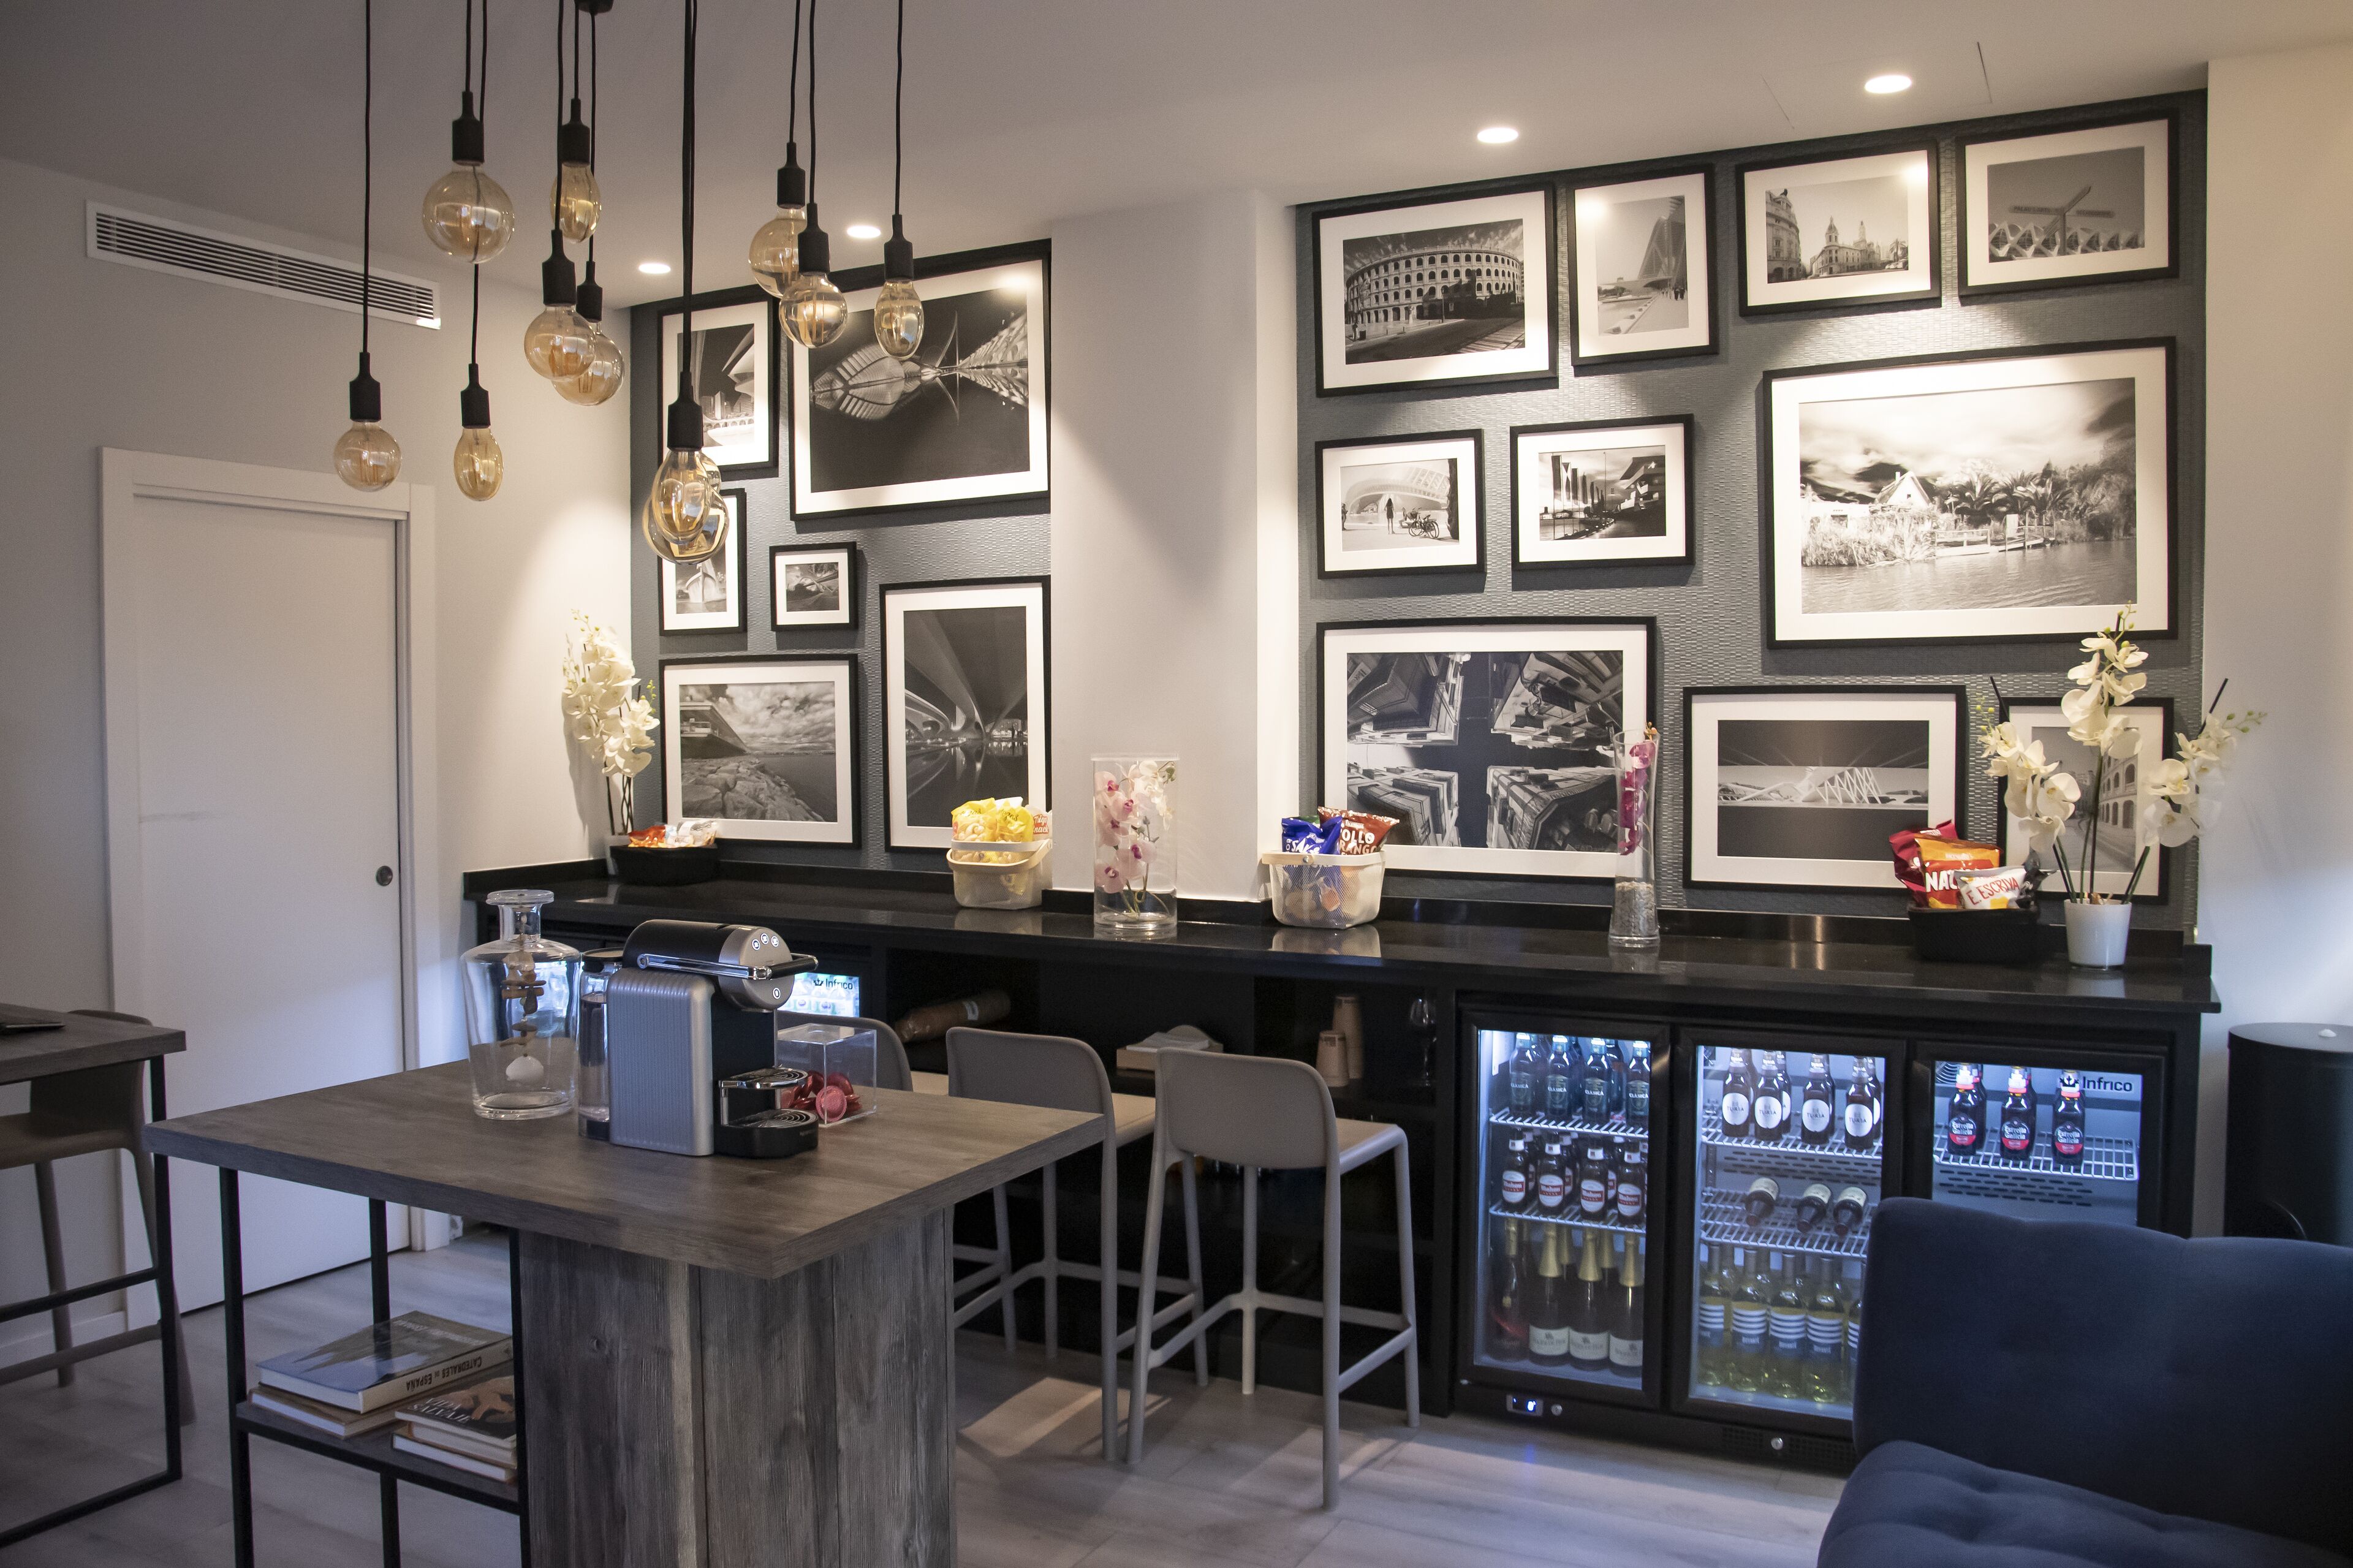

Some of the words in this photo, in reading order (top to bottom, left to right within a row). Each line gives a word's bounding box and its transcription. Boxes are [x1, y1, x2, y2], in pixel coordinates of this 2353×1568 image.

[1341, 828, 1374, 844] OLLO
[1925, 869, 1970, 893] NAC
[825, 978, 853, 990] Infrico
[2083, 1076, 2133, 1092] Infrico
[442, 1356, 482, 1379] CATEDRALES
[406, 1373, 433, 1392] ESPAÑA
